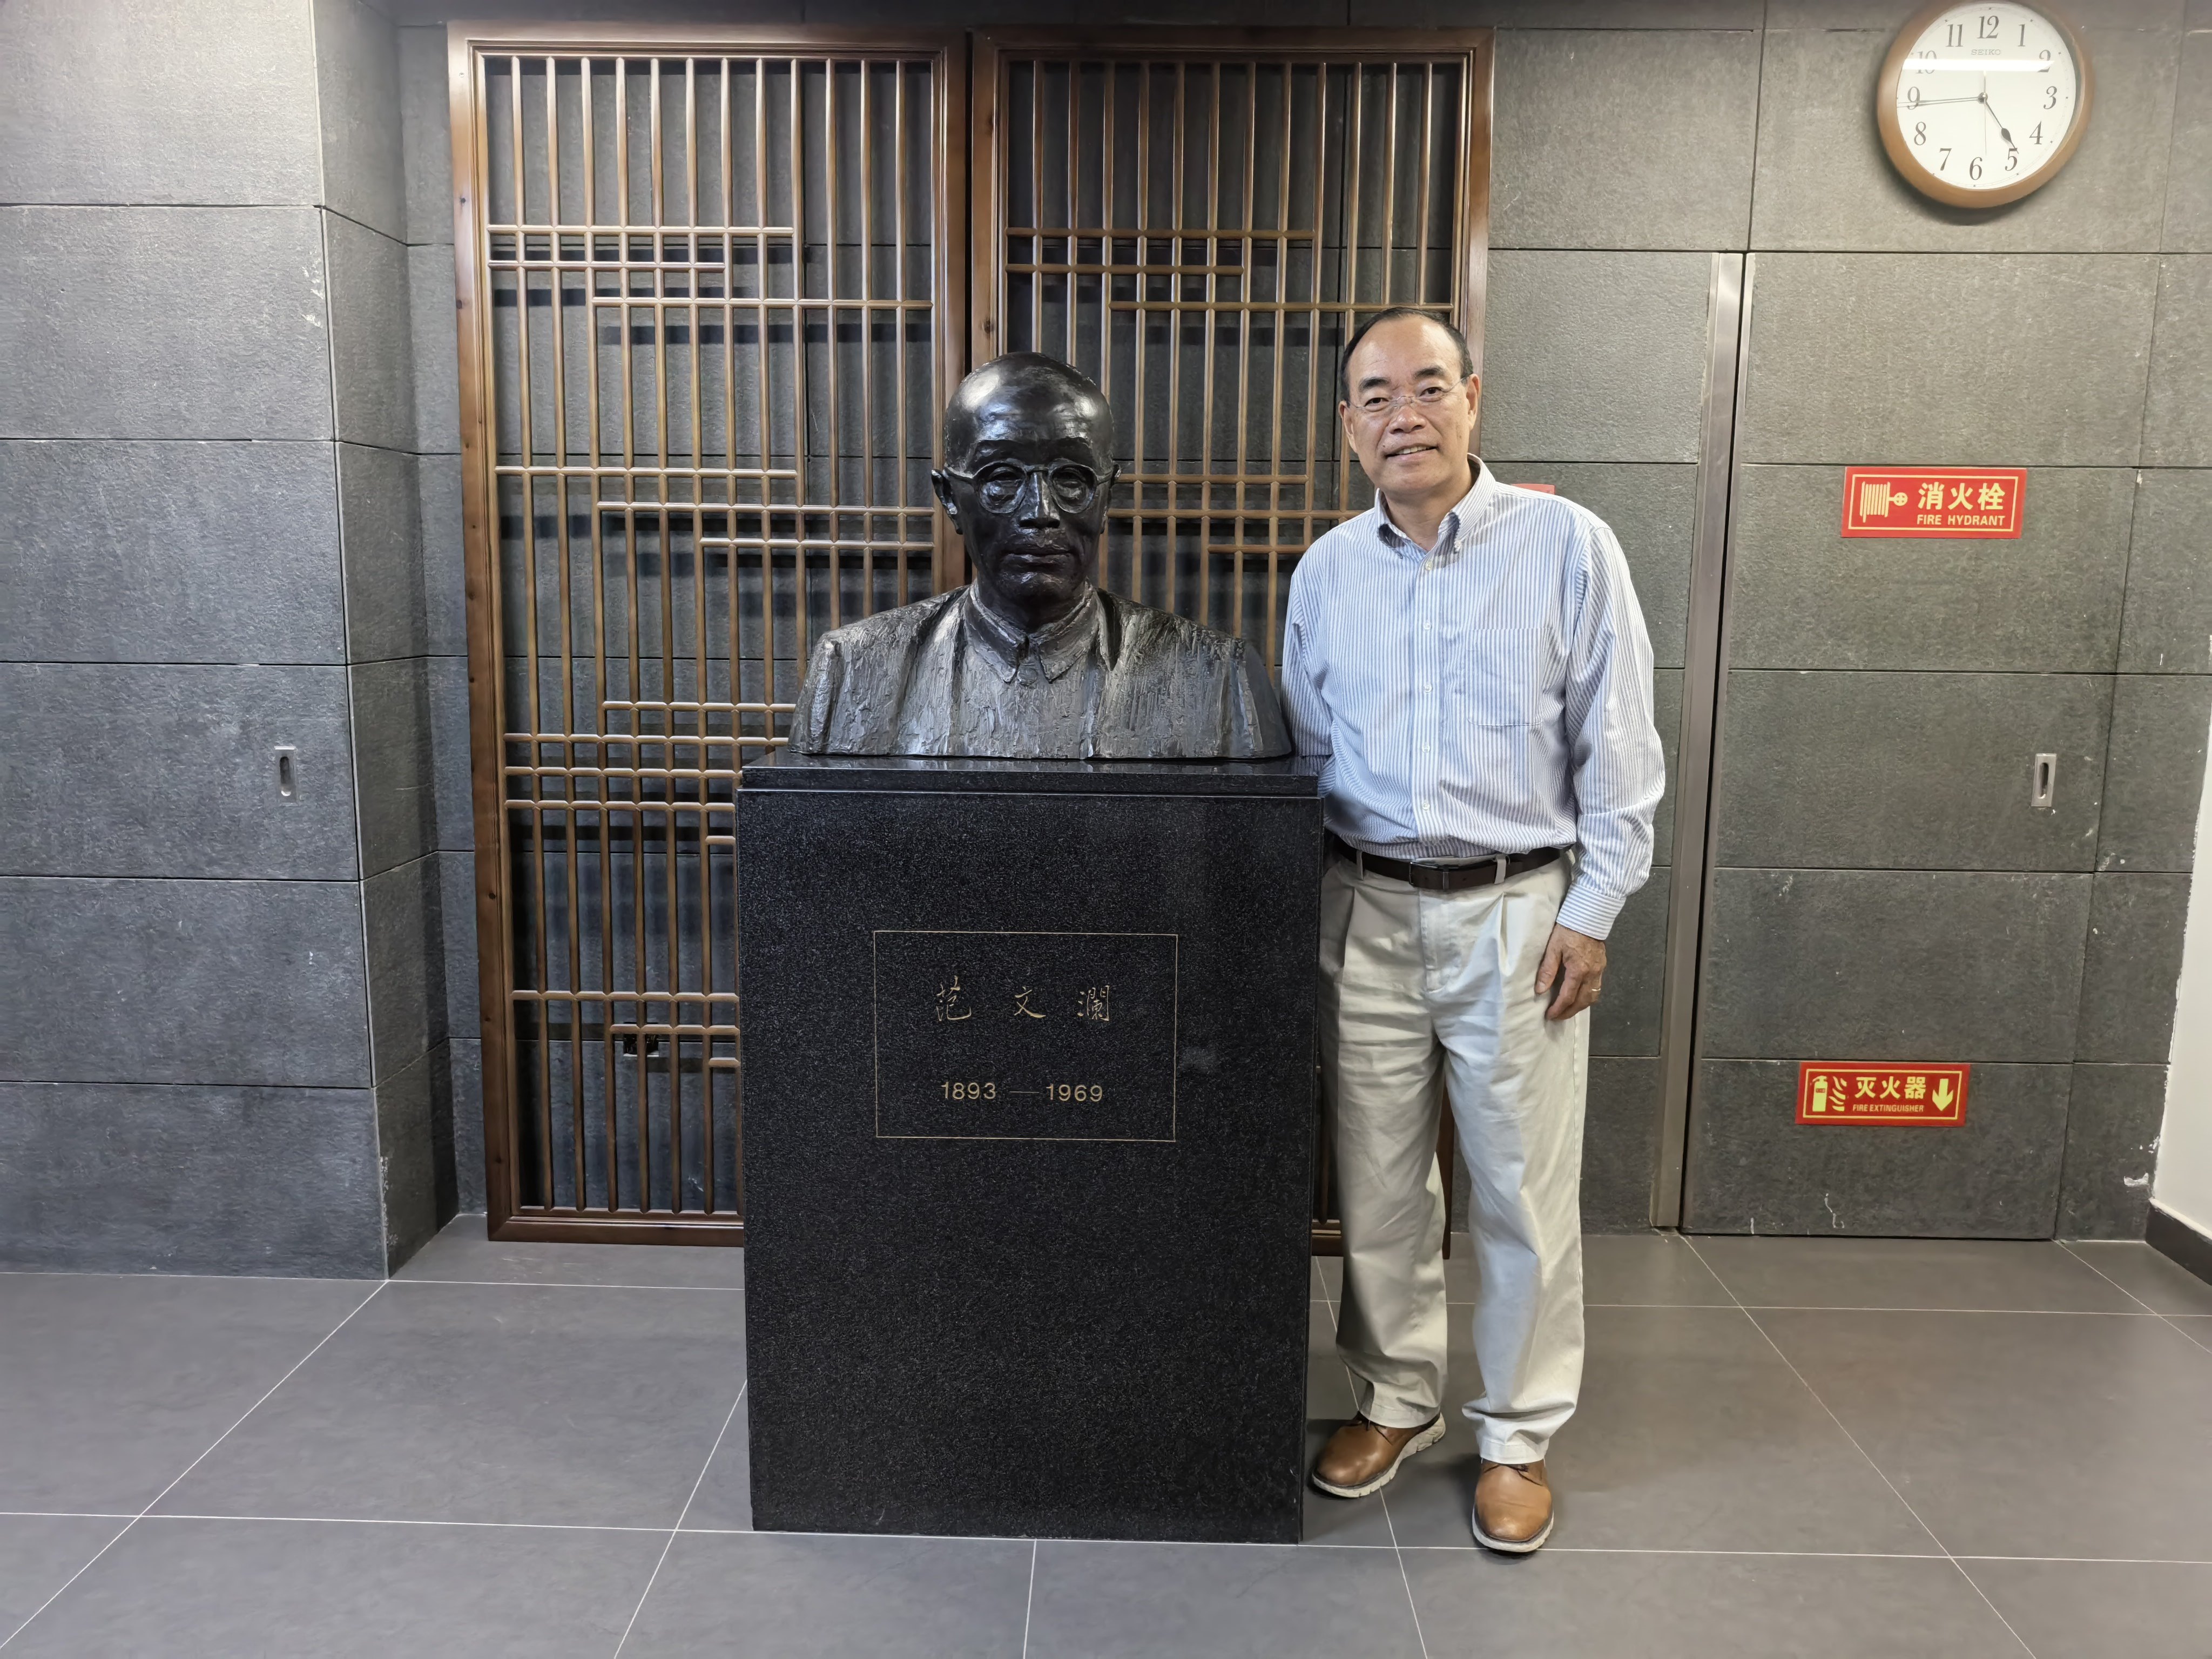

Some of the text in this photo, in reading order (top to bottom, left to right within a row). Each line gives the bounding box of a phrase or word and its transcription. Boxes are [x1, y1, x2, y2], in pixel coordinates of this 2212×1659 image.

[1945, 24, 1964, 48] 11
[1977, 15, 1999, 39] 12
[2017, 24, 2026, 47] 1
[1906, 86, 1920, 110] 9
[2043, 86, 2058, 110] 3
[1913, 122, 1927, 146] 8
[2029, 121, 2044, 145] 4
[1939, 147, 1952, 171] 7
[1969, 157, 1982, 180] 6
[2005, 147, 2018, 172] 5
[1918, 481, 2006, 511] 消火栓
[1917, 514, 2006, 526] FIRE HYDRANT
[1854, 1076, 1926, 1099] 灭火器
